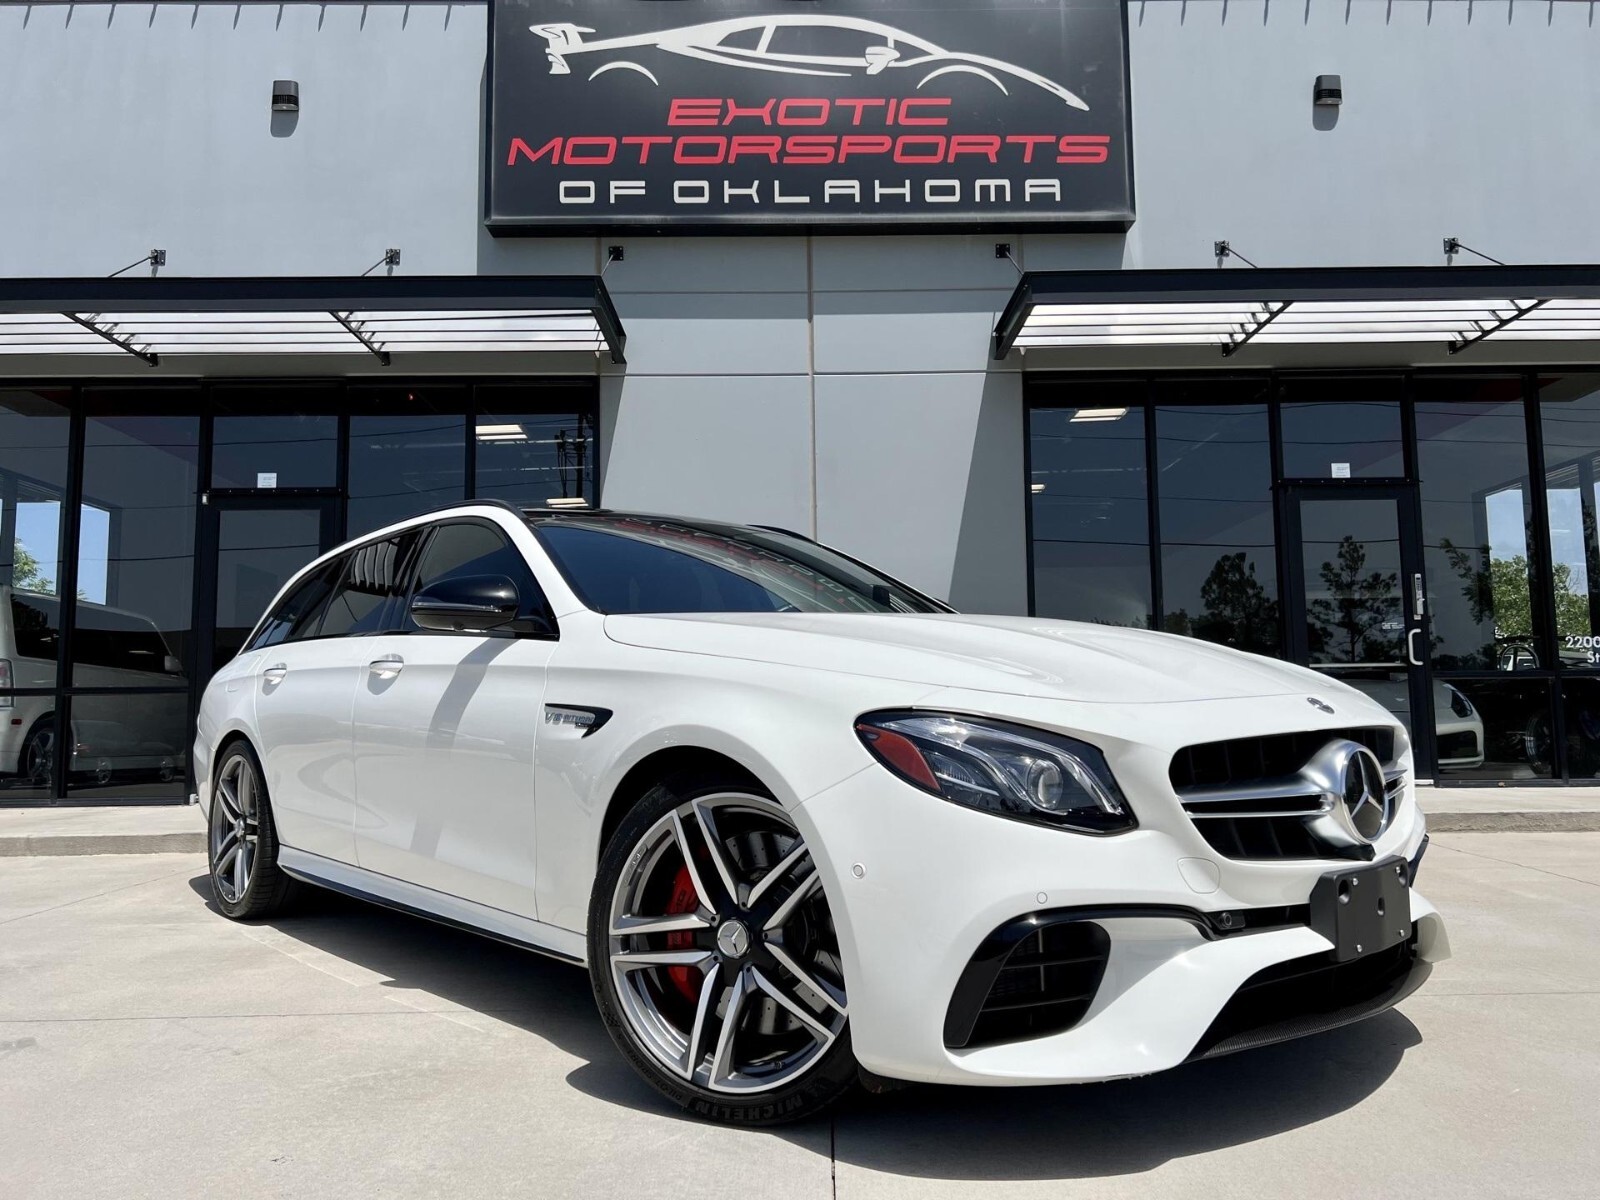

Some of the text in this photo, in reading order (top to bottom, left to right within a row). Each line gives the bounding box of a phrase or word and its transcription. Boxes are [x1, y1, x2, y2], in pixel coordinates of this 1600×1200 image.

[667, 97, 951, 127] EXOTIC
[507, 134, 1110, 166] MOTORSPORTS
[559, 179, 1061, 204] OF OKLAHOMA
[695, 1094, 803, 1120] MICHELIN
